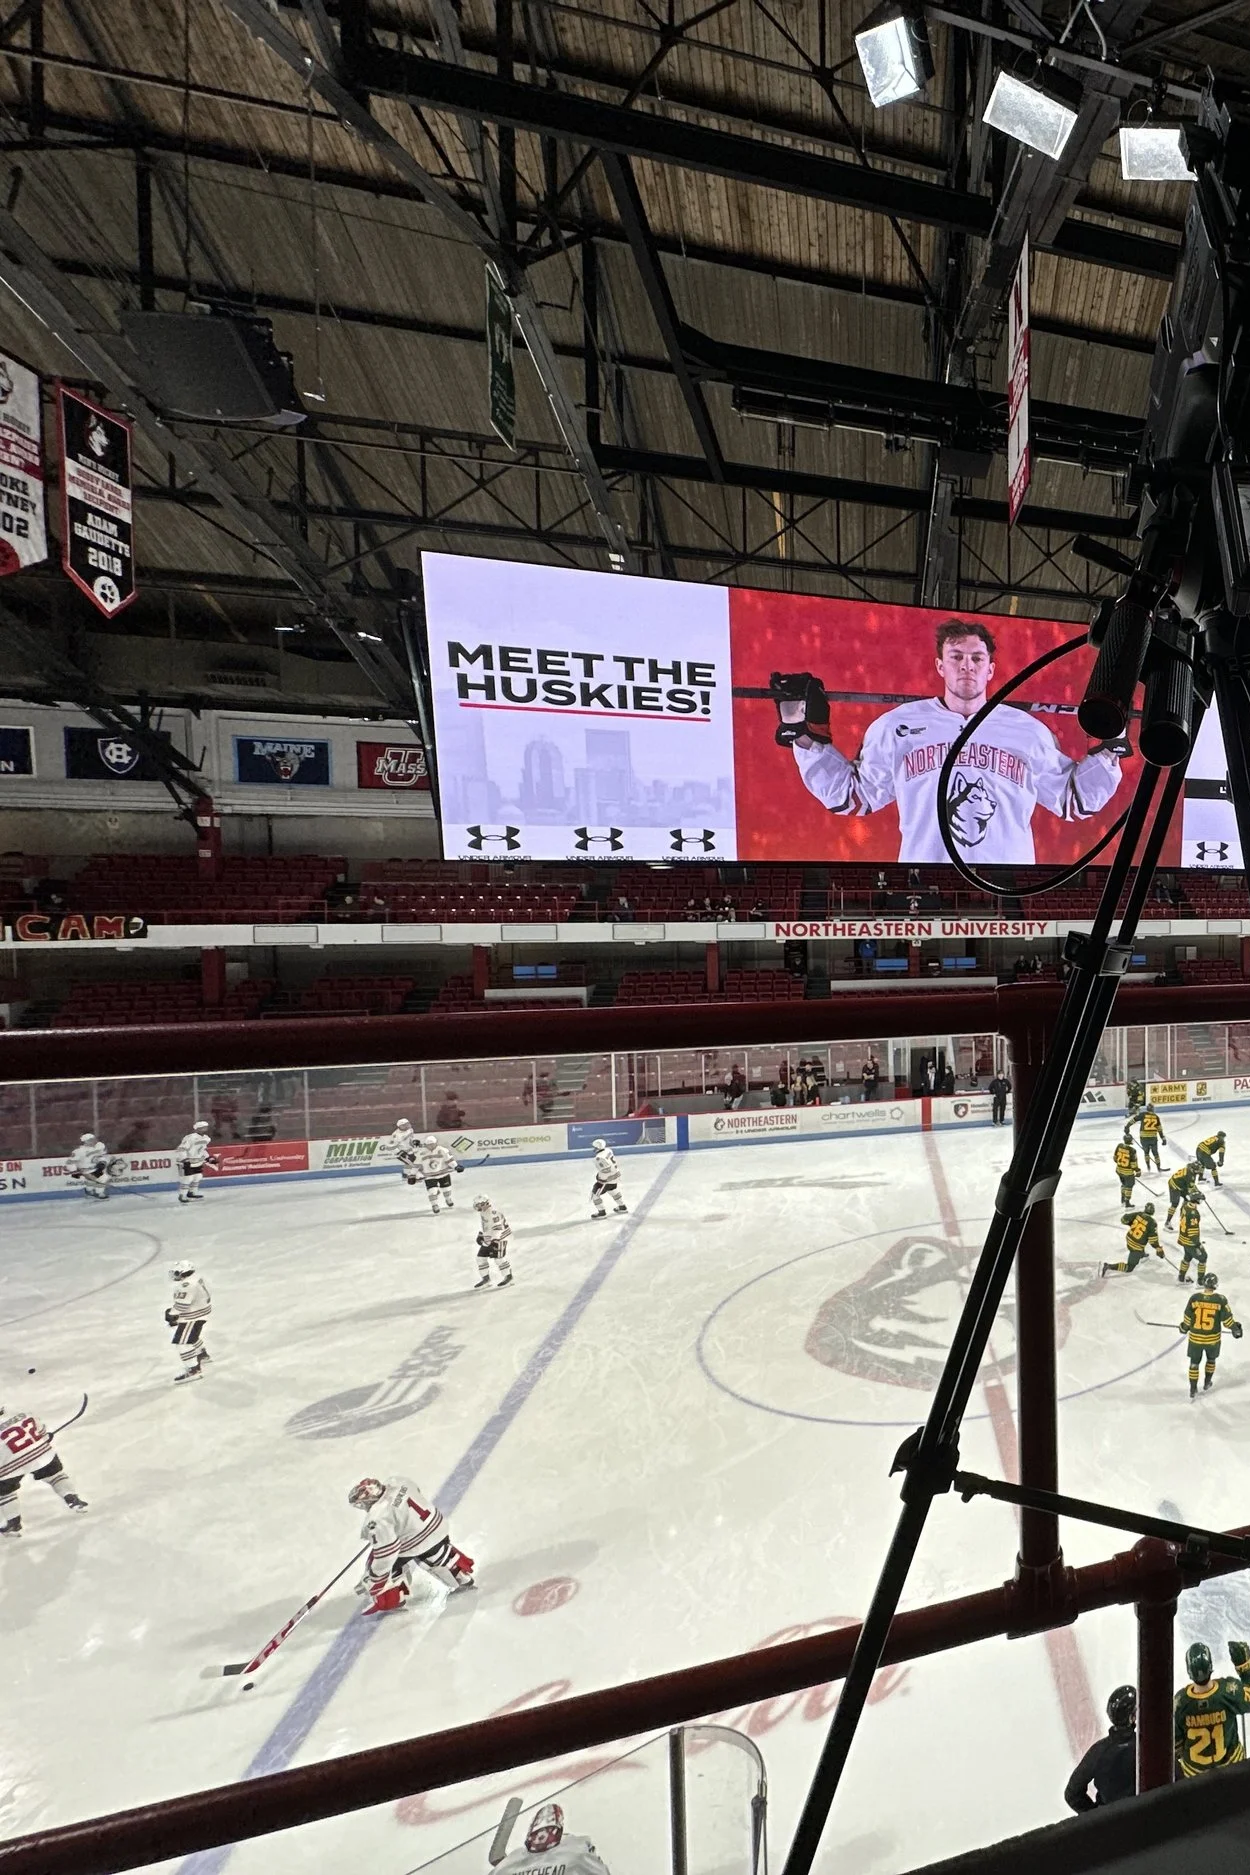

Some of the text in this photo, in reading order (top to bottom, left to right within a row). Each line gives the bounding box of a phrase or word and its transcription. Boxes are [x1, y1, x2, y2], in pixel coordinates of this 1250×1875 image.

[86, 512, 119, 538] ADAM
[87, 546, 123, 577] 2018
[446, 640, 717, 688] MEET THE
[456, 672, 712, 716] HUSKIES!
[252, 741, 316, 759] MAINE
[902, 740, 1026, 788] NORTEASTERN
[15, 913, 127, 941] CAM
[774, 921, 1049, 938] NORTHEASTERN UNIVERSITY
[1161, 1084, 1186, 1093] ARMY
[1150, 1094, 1187, 1103] OFFICER
[727, 1114, 798, 1129] NORTHEASTERN
[820, 1108, 887, 1121] chartwells
[1143, 1118, 1158, 1131] 22
[326, 1140, 379, 1158] MIW
[477, 1135, 552, 1147] SOURCEPROMO
[6, 1161, 23, 1172] ON
[130, 1158, 172, 1171] RADIO
[324, 1155, 373, 1164] CORPORATION
[1193, 1307, 1216, 1331] 15
[0, 1416, 41, 1455] 22
[406, 1496, 432, 1522] 1
[1185, 1709, 1227, 1727] SAMBUCO
[1186, 1723, 1227, 1765] 21
